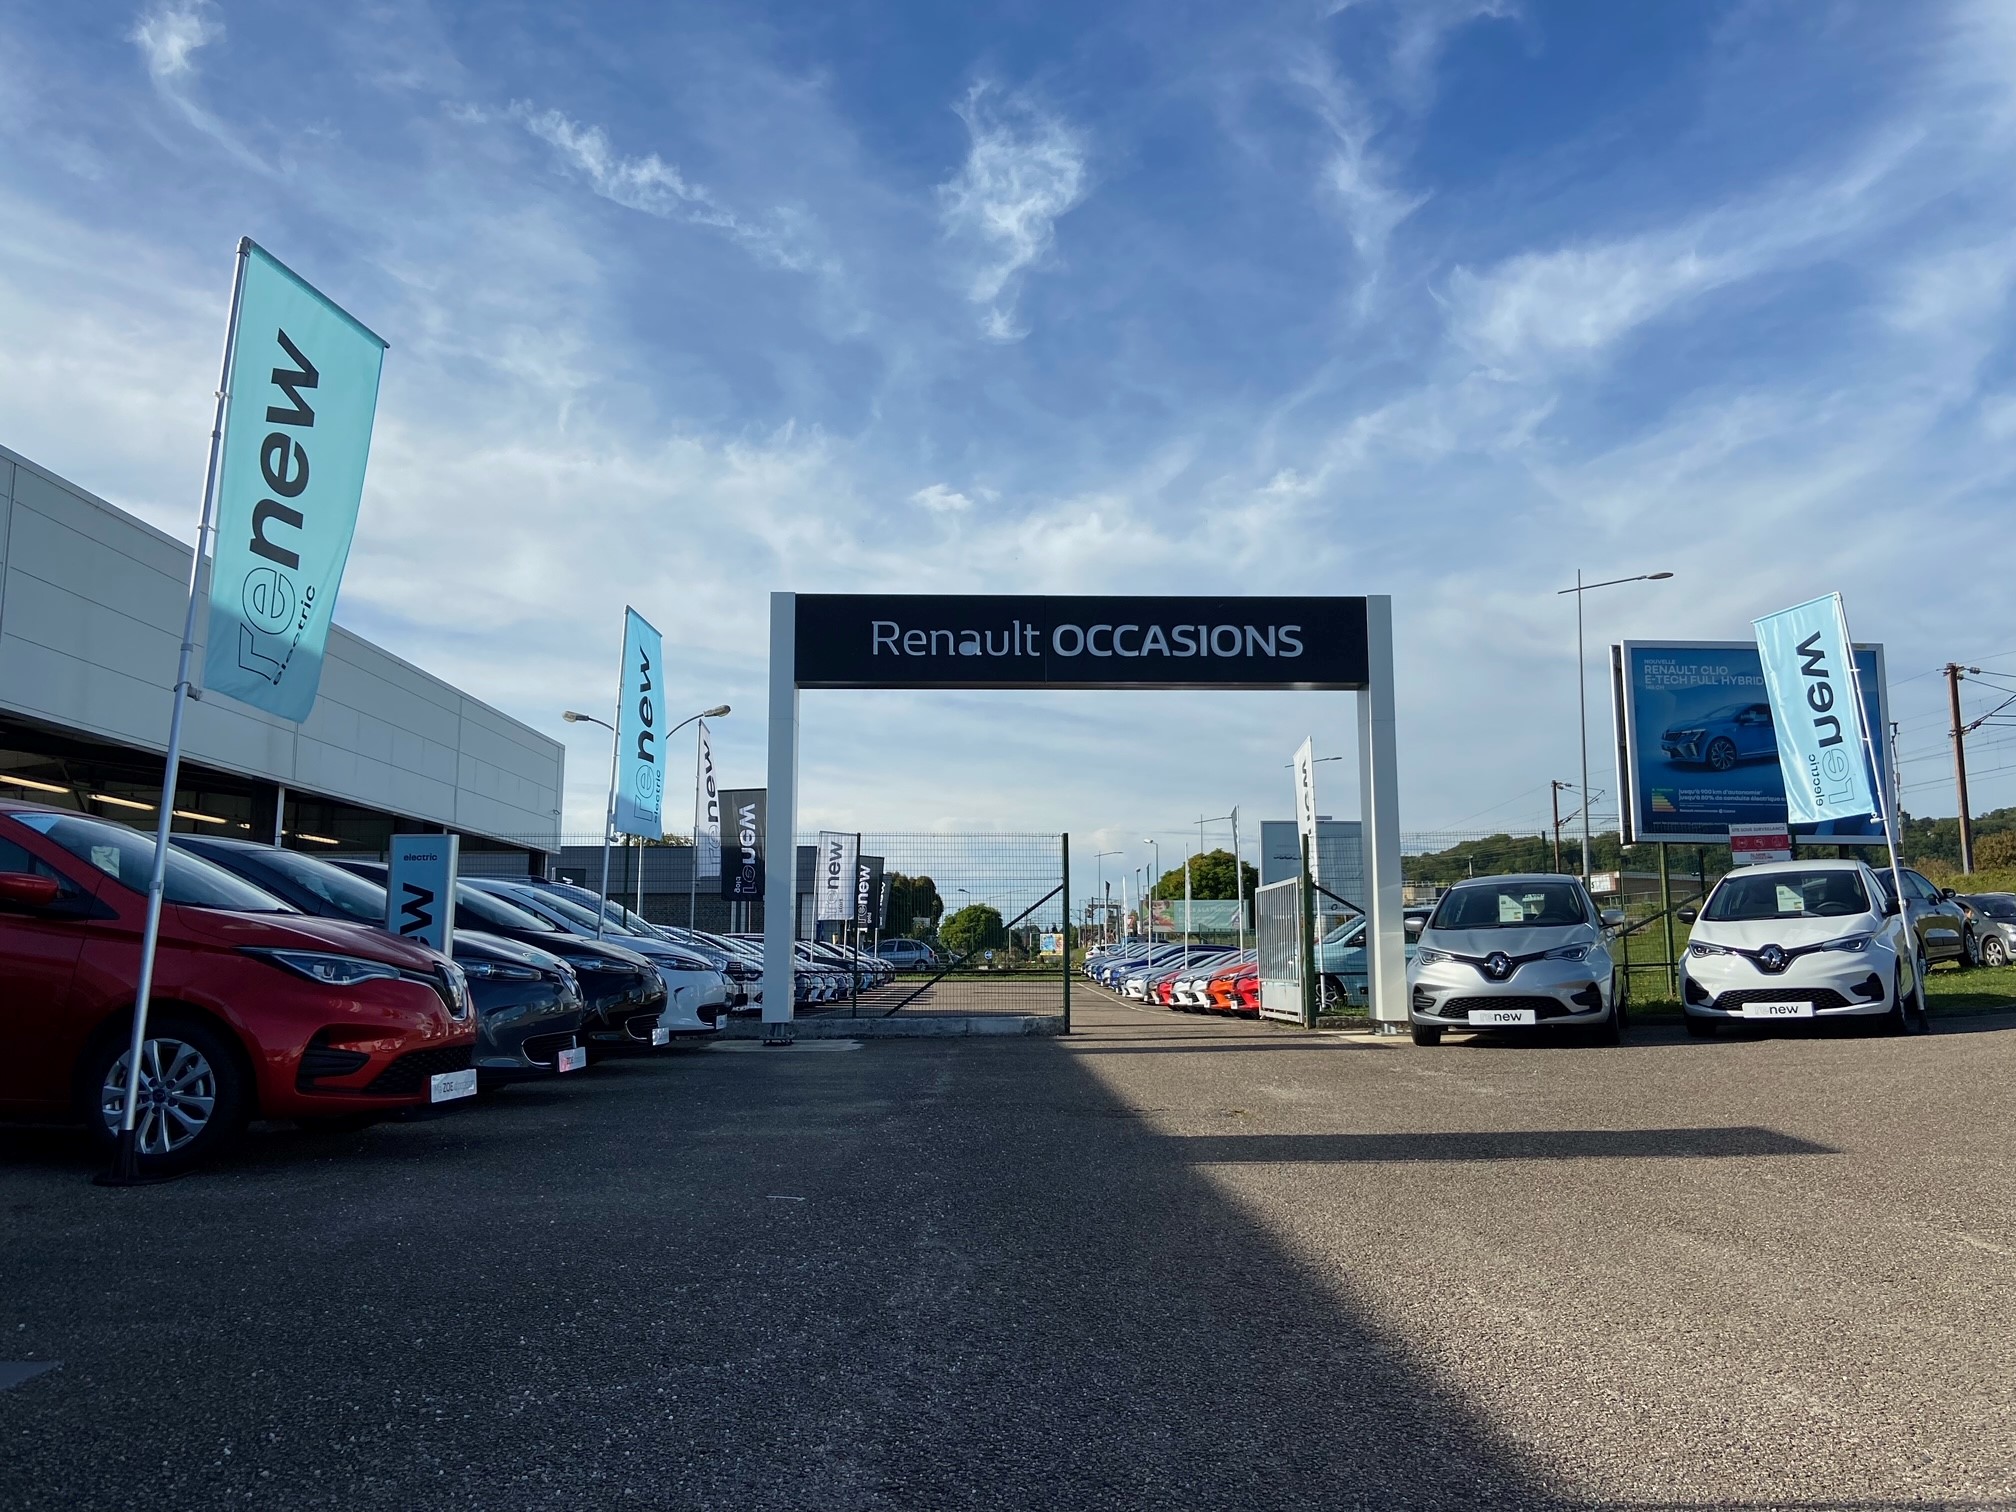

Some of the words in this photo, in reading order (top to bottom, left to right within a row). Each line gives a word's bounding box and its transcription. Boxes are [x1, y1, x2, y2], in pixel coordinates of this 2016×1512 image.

[238, 327, 319, 681] renew
[272, 585, 316, 686] electric
[871, 619, 1040, 657] Renault
[1052, 623, 1304, 657] OCCASIONS
[1644, 665, 1697, 675] RENAULT
[1700, 666, 1728, 675] CLIO
[1644, 675, 1690, 685] E-TECH
[1690, 676, 1719, 685] FULL
[1721, 676, 1765, 686] HYBRID
[633, 645, 655, 822] renew
[403, 853, 438, 861] electric
